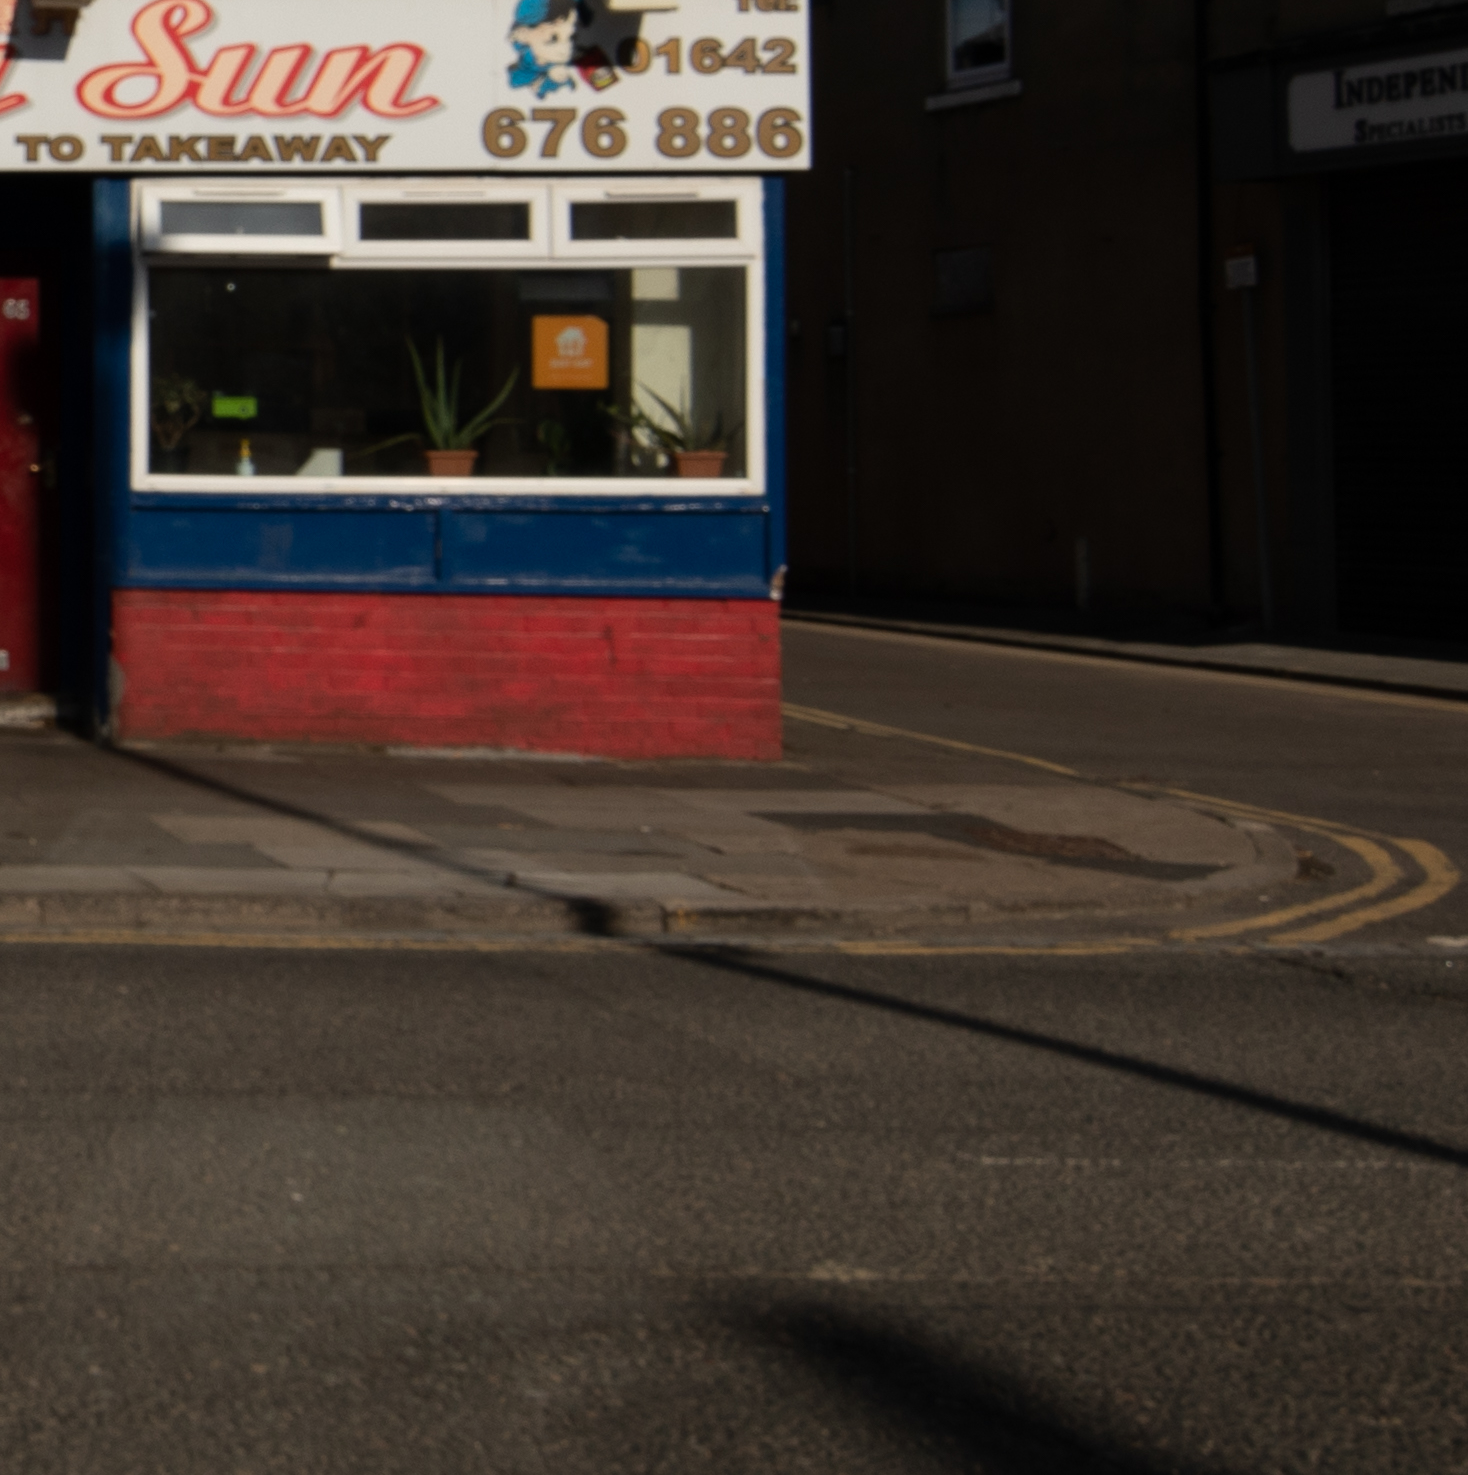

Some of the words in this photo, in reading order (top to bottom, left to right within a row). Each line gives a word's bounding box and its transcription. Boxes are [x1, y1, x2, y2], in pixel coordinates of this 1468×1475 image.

[618, 36, 798, 75] 01642
[15, 134, 84, 164] TO
[100, 134, 392, 164] TAKEAWAY
[481, 107, 628, 159] 676
[654, 106, 804, 159] 886
